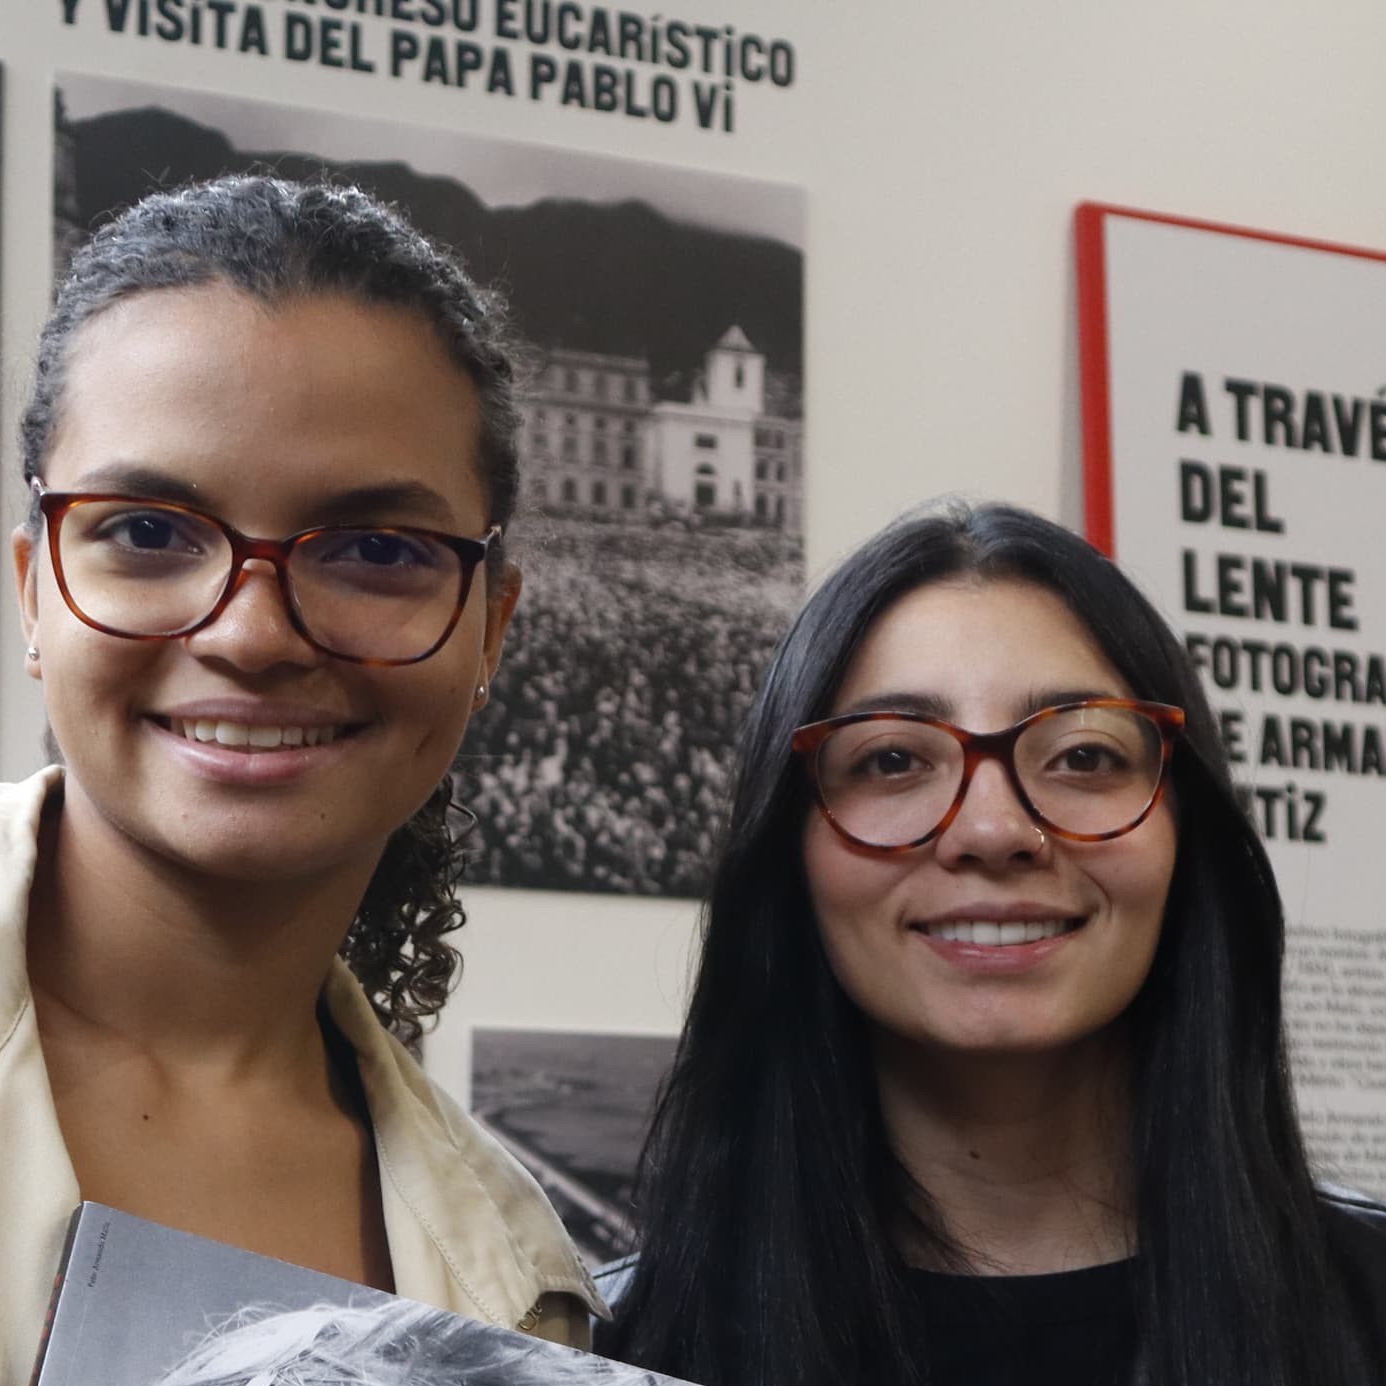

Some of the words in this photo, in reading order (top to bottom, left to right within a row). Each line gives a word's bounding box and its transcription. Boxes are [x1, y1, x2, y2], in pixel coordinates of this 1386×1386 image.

[285, 11, 374, 73] DEL
[391, 29, 514, 97] PAPA
[529, 52, 677, 122] PABLO
[1177, 371, 1210, 436] A
[1178, 459, 1285, 534] DEL
[1182, 549, 1359, 631] LENTE
